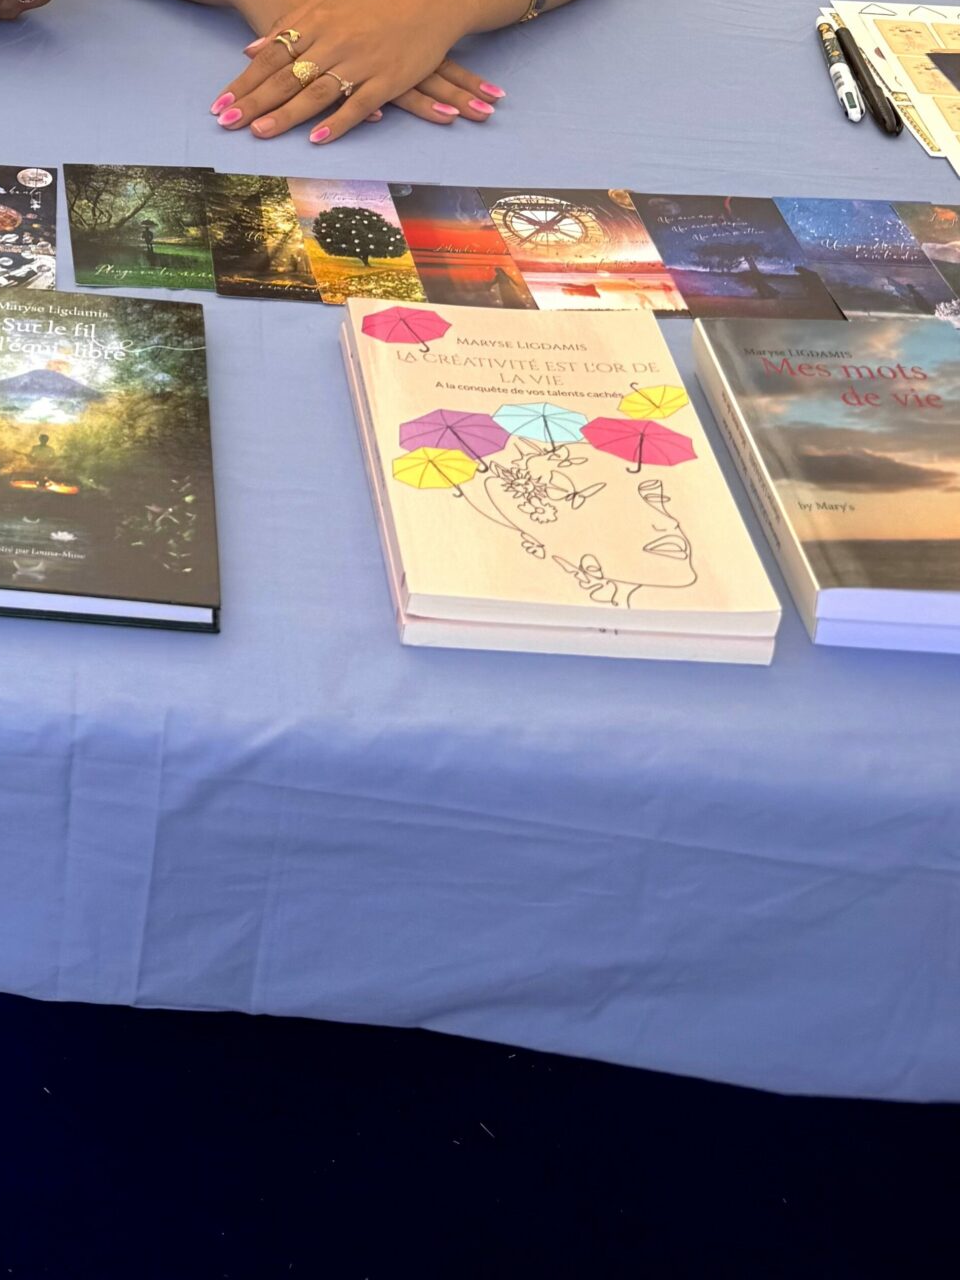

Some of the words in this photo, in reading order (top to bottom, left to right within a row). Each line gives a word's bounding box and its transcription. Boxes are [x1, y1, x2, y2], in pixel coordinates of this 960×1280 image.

[48, 305, 108, 318] Ligdamis
[2, 317, 42, 333] Sur
[48, 320, 67, 336] le
[74, 322, 96, 338] fil
[517, 340, 588, 352] LIGDAMIS
[396, 350, 418, 364] LA
[423, 353, 540, 371] CRÉATIVITÉ
[546, 361, 577, 372] EST
[584, 361, 625, 373] L'OR
[632, 362, 660, 373] DE
[761, 356, 832, 379] Mes
[841, 363, 928, 381] mots
[499, 372, 526, 384] LA
[530, 375, 565, 386] VIE
[445, 381, 456, 390] la
[457, 383, 509, 395] conquête
[511, 387, 525, 395] de
[525, 389, 544, 397] vos
[546, 389, 585, 398] talents
[840, 385, 881, 408] de
[892, 387, 944, 409] vie
[797, 501, 813, 511] by
